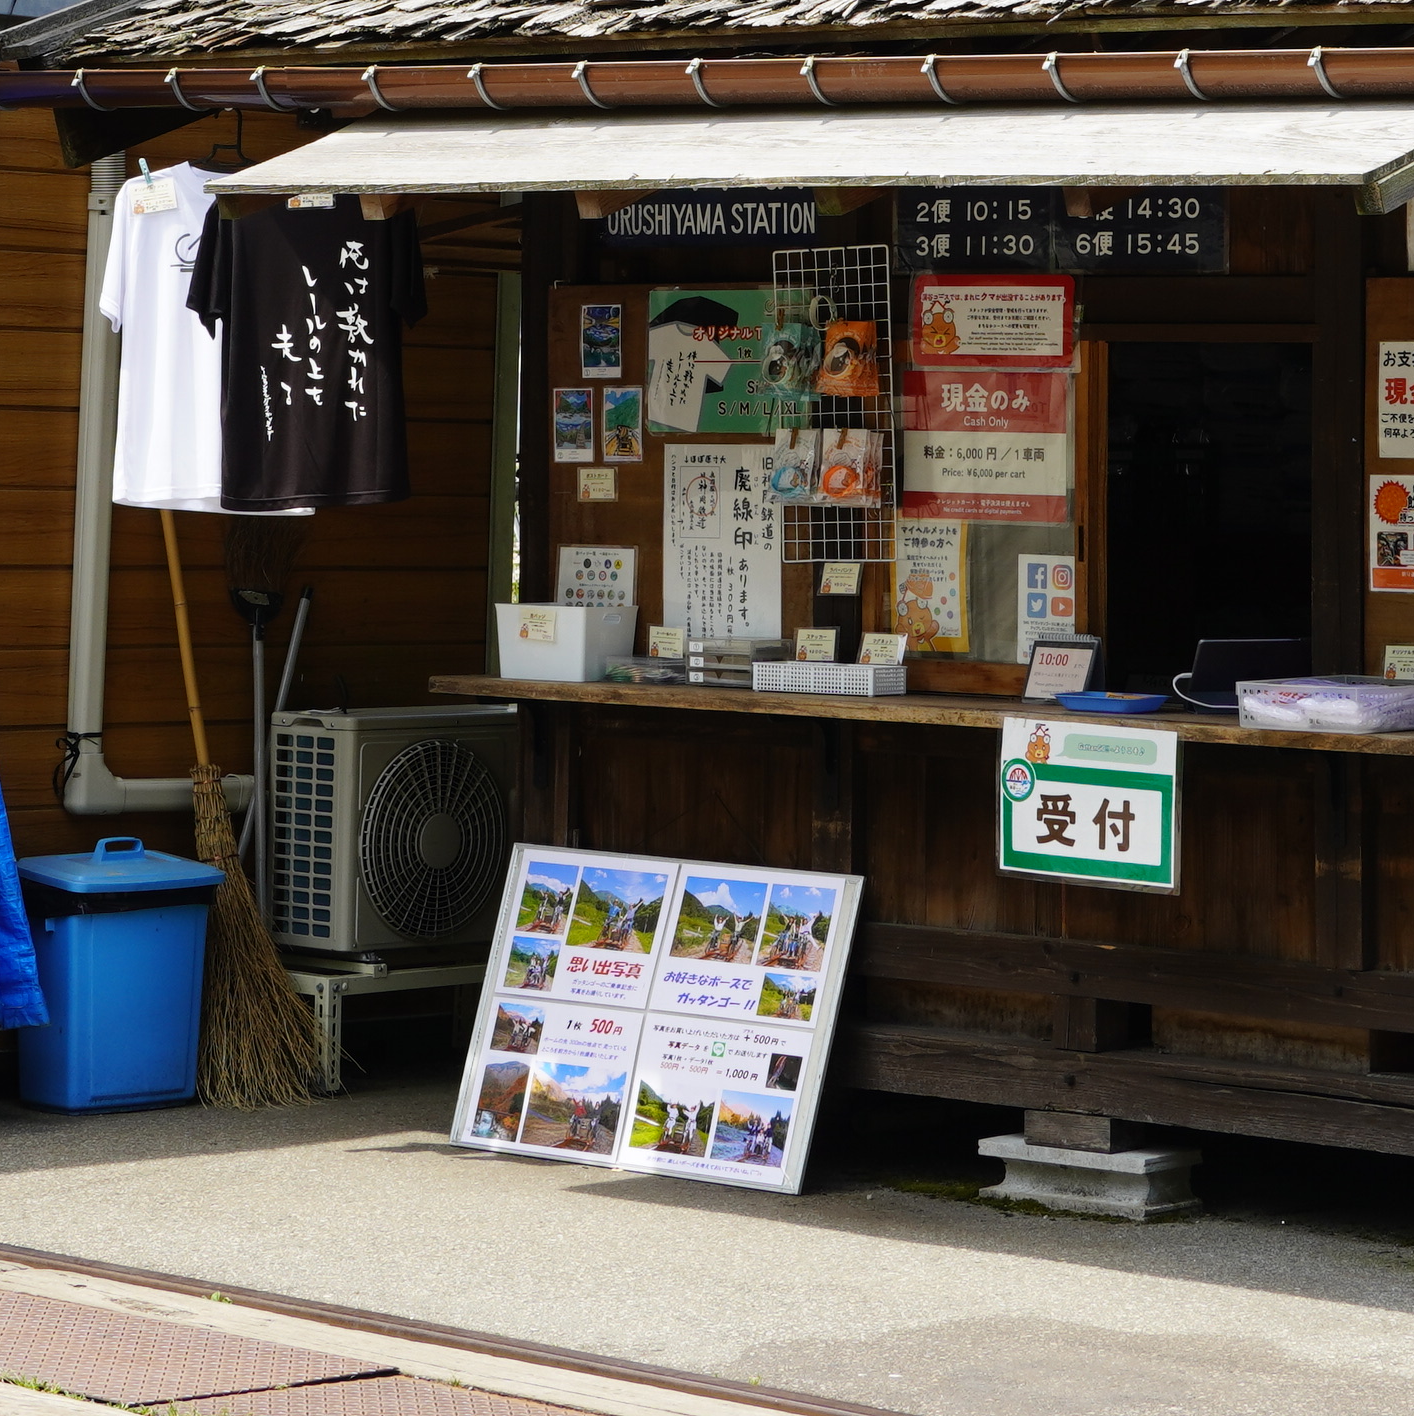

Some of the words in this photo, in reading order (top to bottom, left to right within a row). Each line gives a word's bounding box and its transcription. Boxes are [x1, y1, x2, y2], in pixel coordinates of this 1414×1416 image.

[607, 202, 727, 236] URUSHIYAMA
[730, 201, 817, 235] STATION
[915, 199, 952, 224] 2便
[966, 199, 1032, 222] 10:15
[1128, 197, 1201, 219] 14:30
[915, 233, 951, 258] 3便
[966, 233, 1035, 256] 11:30
[1076, 231, 1114, 257] 6便
[1127, 233, 1200, 255] 15:45
[738, 347, 752, 359] 1枚
[271, 324, 302, 406] 走る
[941, 382, 1031, 413] 現金のみ
[963, 415, 986, 427] Cash
[988, 416, 1009, 429] Only
[942, 468, 964, 477] Price:
[966, 468, 993, 478] ¥6,000
[995, 470, 1008, 480] per
[1010, 470, 1026, 479] cart
[901, 525, 958, 536] マイヘルメットを
[904, 537, 954, 548] ご持参の方へ
[1039, 652, 1069, 667] 10:00
[1035, 793, 1136, 852] 受付
[566, 955, 645, 980] 思い出写真
[663, 971, 754, 990] お好きなポーズで
[589, 1018, 623, 1035] 500円
